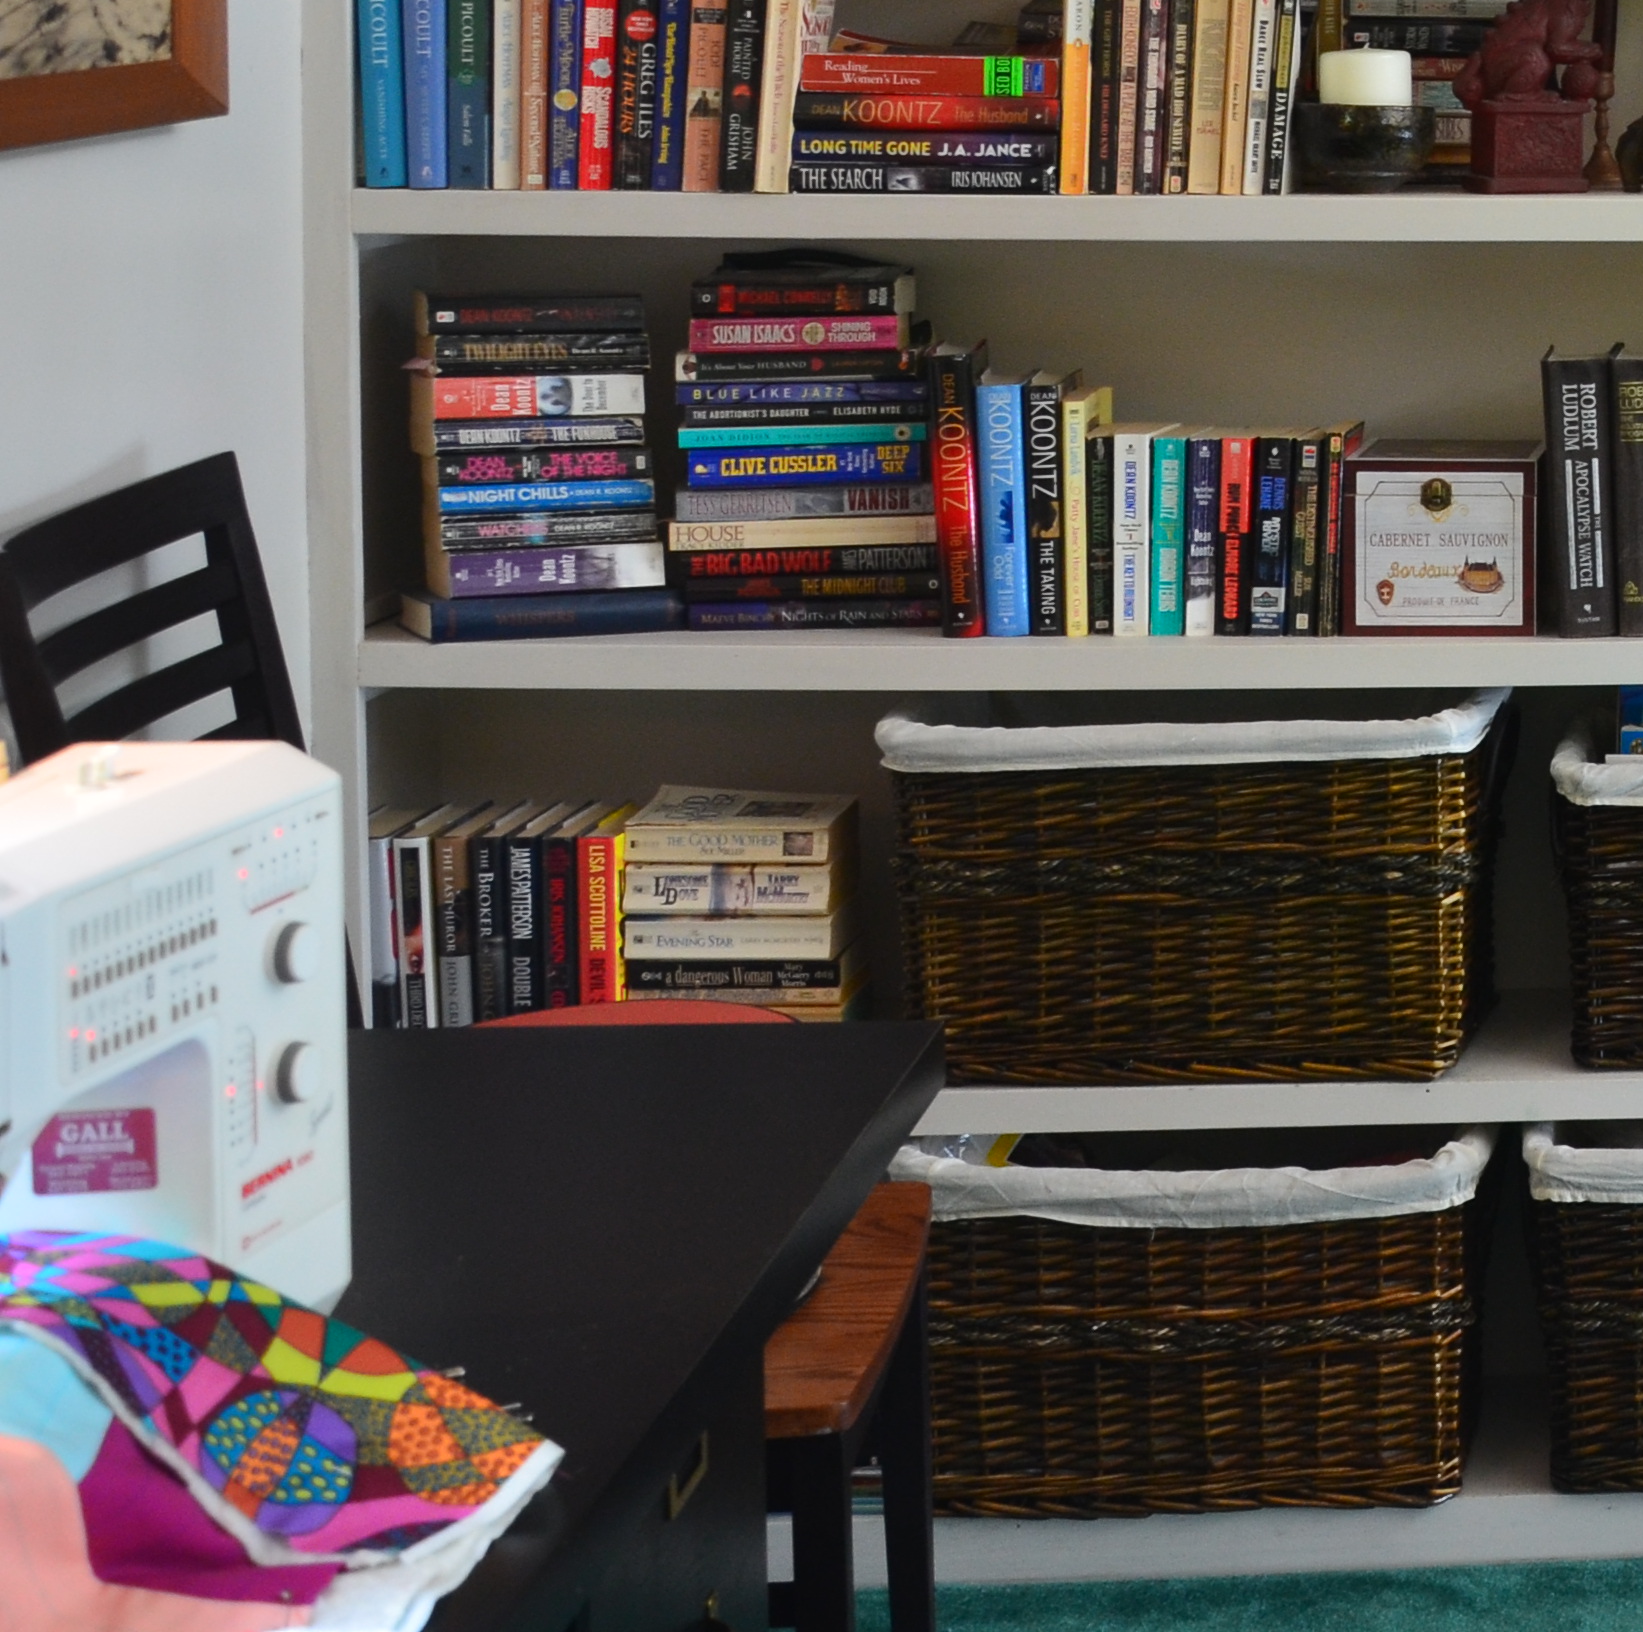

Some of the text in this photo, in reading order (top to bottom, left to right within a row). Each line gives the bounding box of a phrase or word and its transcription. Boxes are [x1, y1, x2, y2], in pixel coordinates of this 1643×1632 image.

[620, 47, 635, 133] 24 HOURS
[638, 43, 655, 138] GREG ILES
[801, 140, 930, 156] LONG TIME GONE
[938, 144, 1031, 157] J.A. JANCE
[801, 168, 882, 189] THE SEARCH
[952, 171, 1021, 187] IRIS JOHANSEN
[693, 388, 844, 400] BLUE LIKE JAZZ
[1562, 385, 1580, 451] LUDLUM
[1579, 384, 1598, 450] ROBERT
[1030, 400, 1059, 500] KOONTZ
[721, 454, 837, 476] CLIVE CUSSLER
[1575, 461, 1593, 587] APOCALYPSE WATCH
[1369, 531, 1508, 549] CABERNET SAUVIGNON
[1039, 542, 1055, 615] THE TAKING
[1451, 597, 1479, 606] FRANCE
[588, 846, 606, 950] LISA SCOTTOLINE
[61, 1121, 128, 1143] GALL
